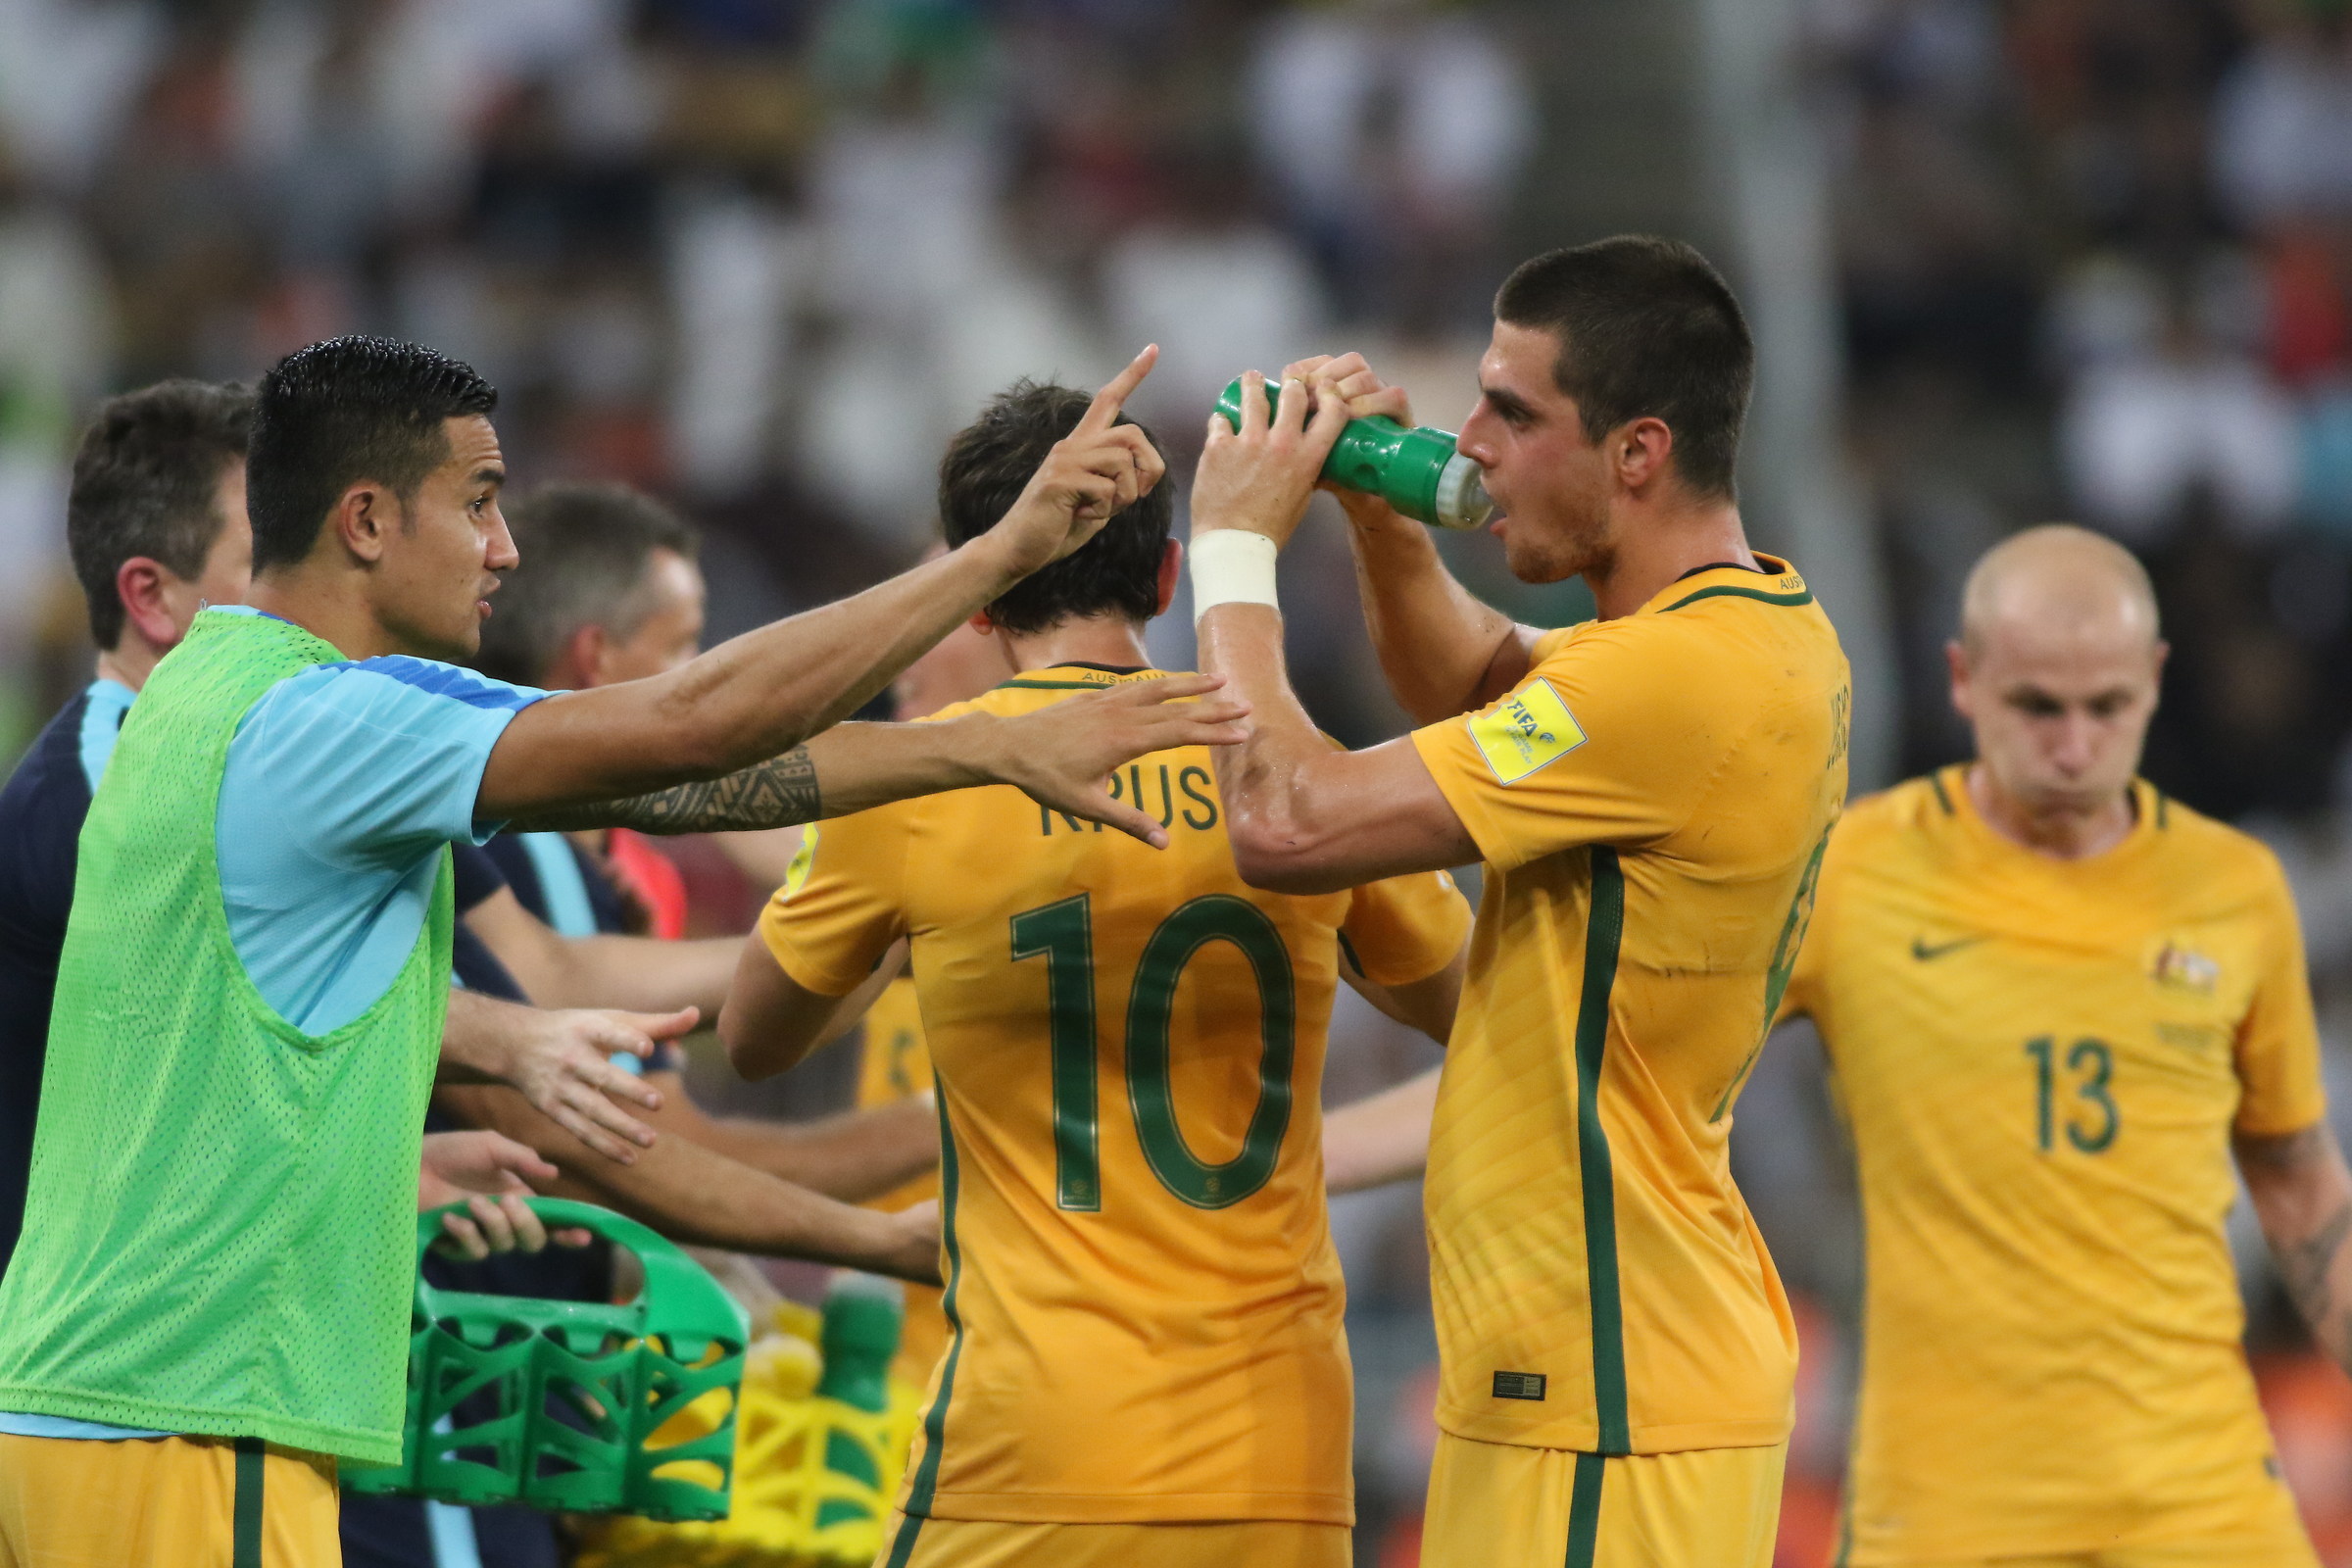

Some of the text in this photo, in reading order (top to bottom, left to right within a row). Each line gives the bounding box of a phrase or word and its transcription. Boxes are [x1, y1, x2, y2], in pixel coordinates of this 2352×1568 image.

[1507, 701, 1538, 737] FIFA
[1009, 892, 1296, 1211] 10
[2025, 1035, 2118, 1153] 13
